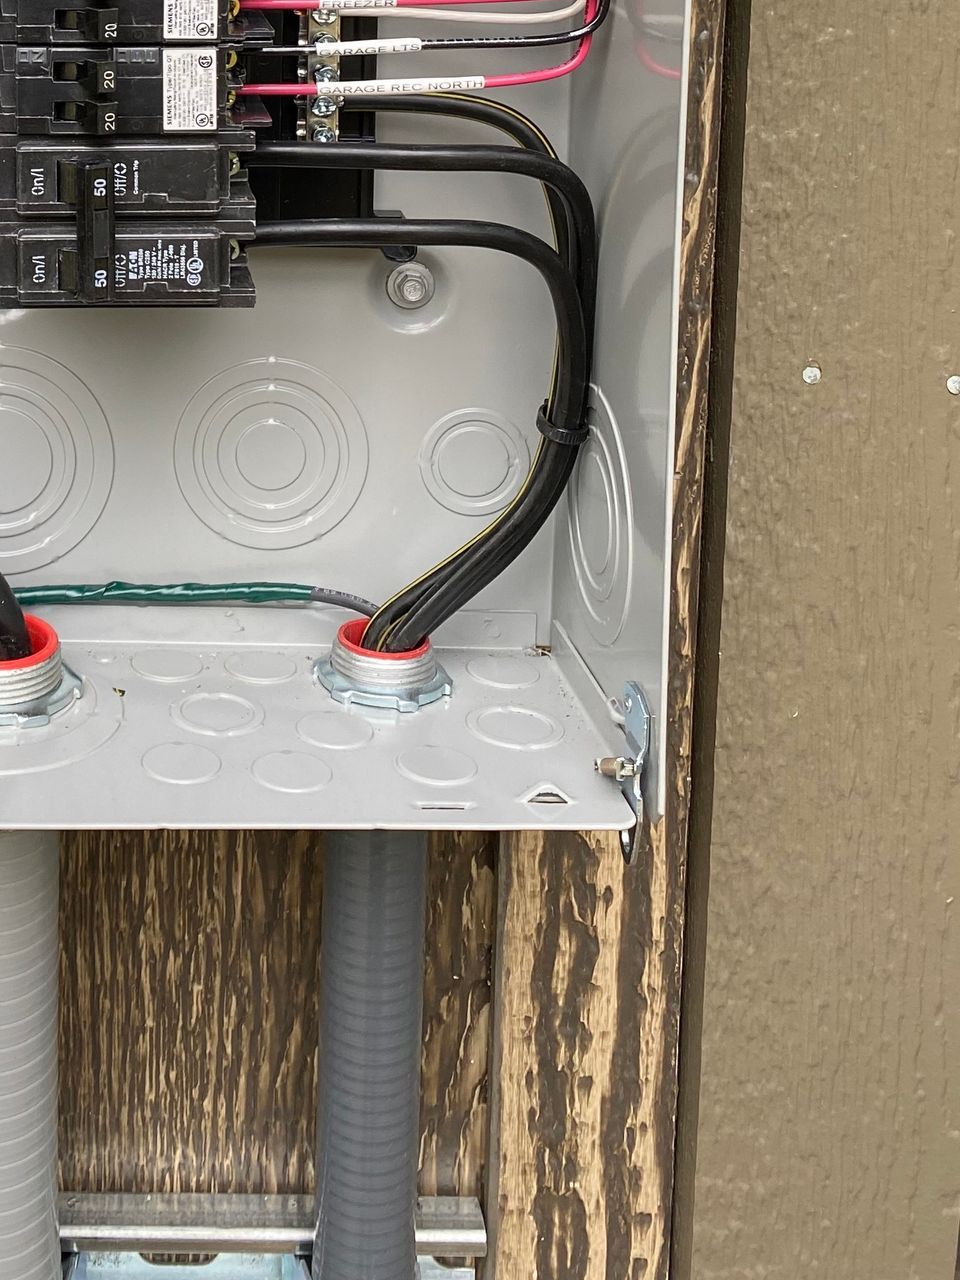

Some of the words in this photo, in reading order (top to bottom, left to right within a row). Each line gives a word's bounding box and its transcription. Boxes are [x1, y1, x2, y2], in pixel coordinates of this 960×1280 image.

[105, 22, 118, 38] 20
[320, 46, 386, 56] GARAGE
[392, 43, 420, 52] LTS
[104, 70, 115, 89] 20
[320, 84, 385, 95] GARAGE
[391, 82, 423, 92] REC
[428, 79, 484, 90] NORTH
[104, 112, 116, 131] 20
[94, 178, 106, 197] 50
[94, 270, 107, 288] 50
